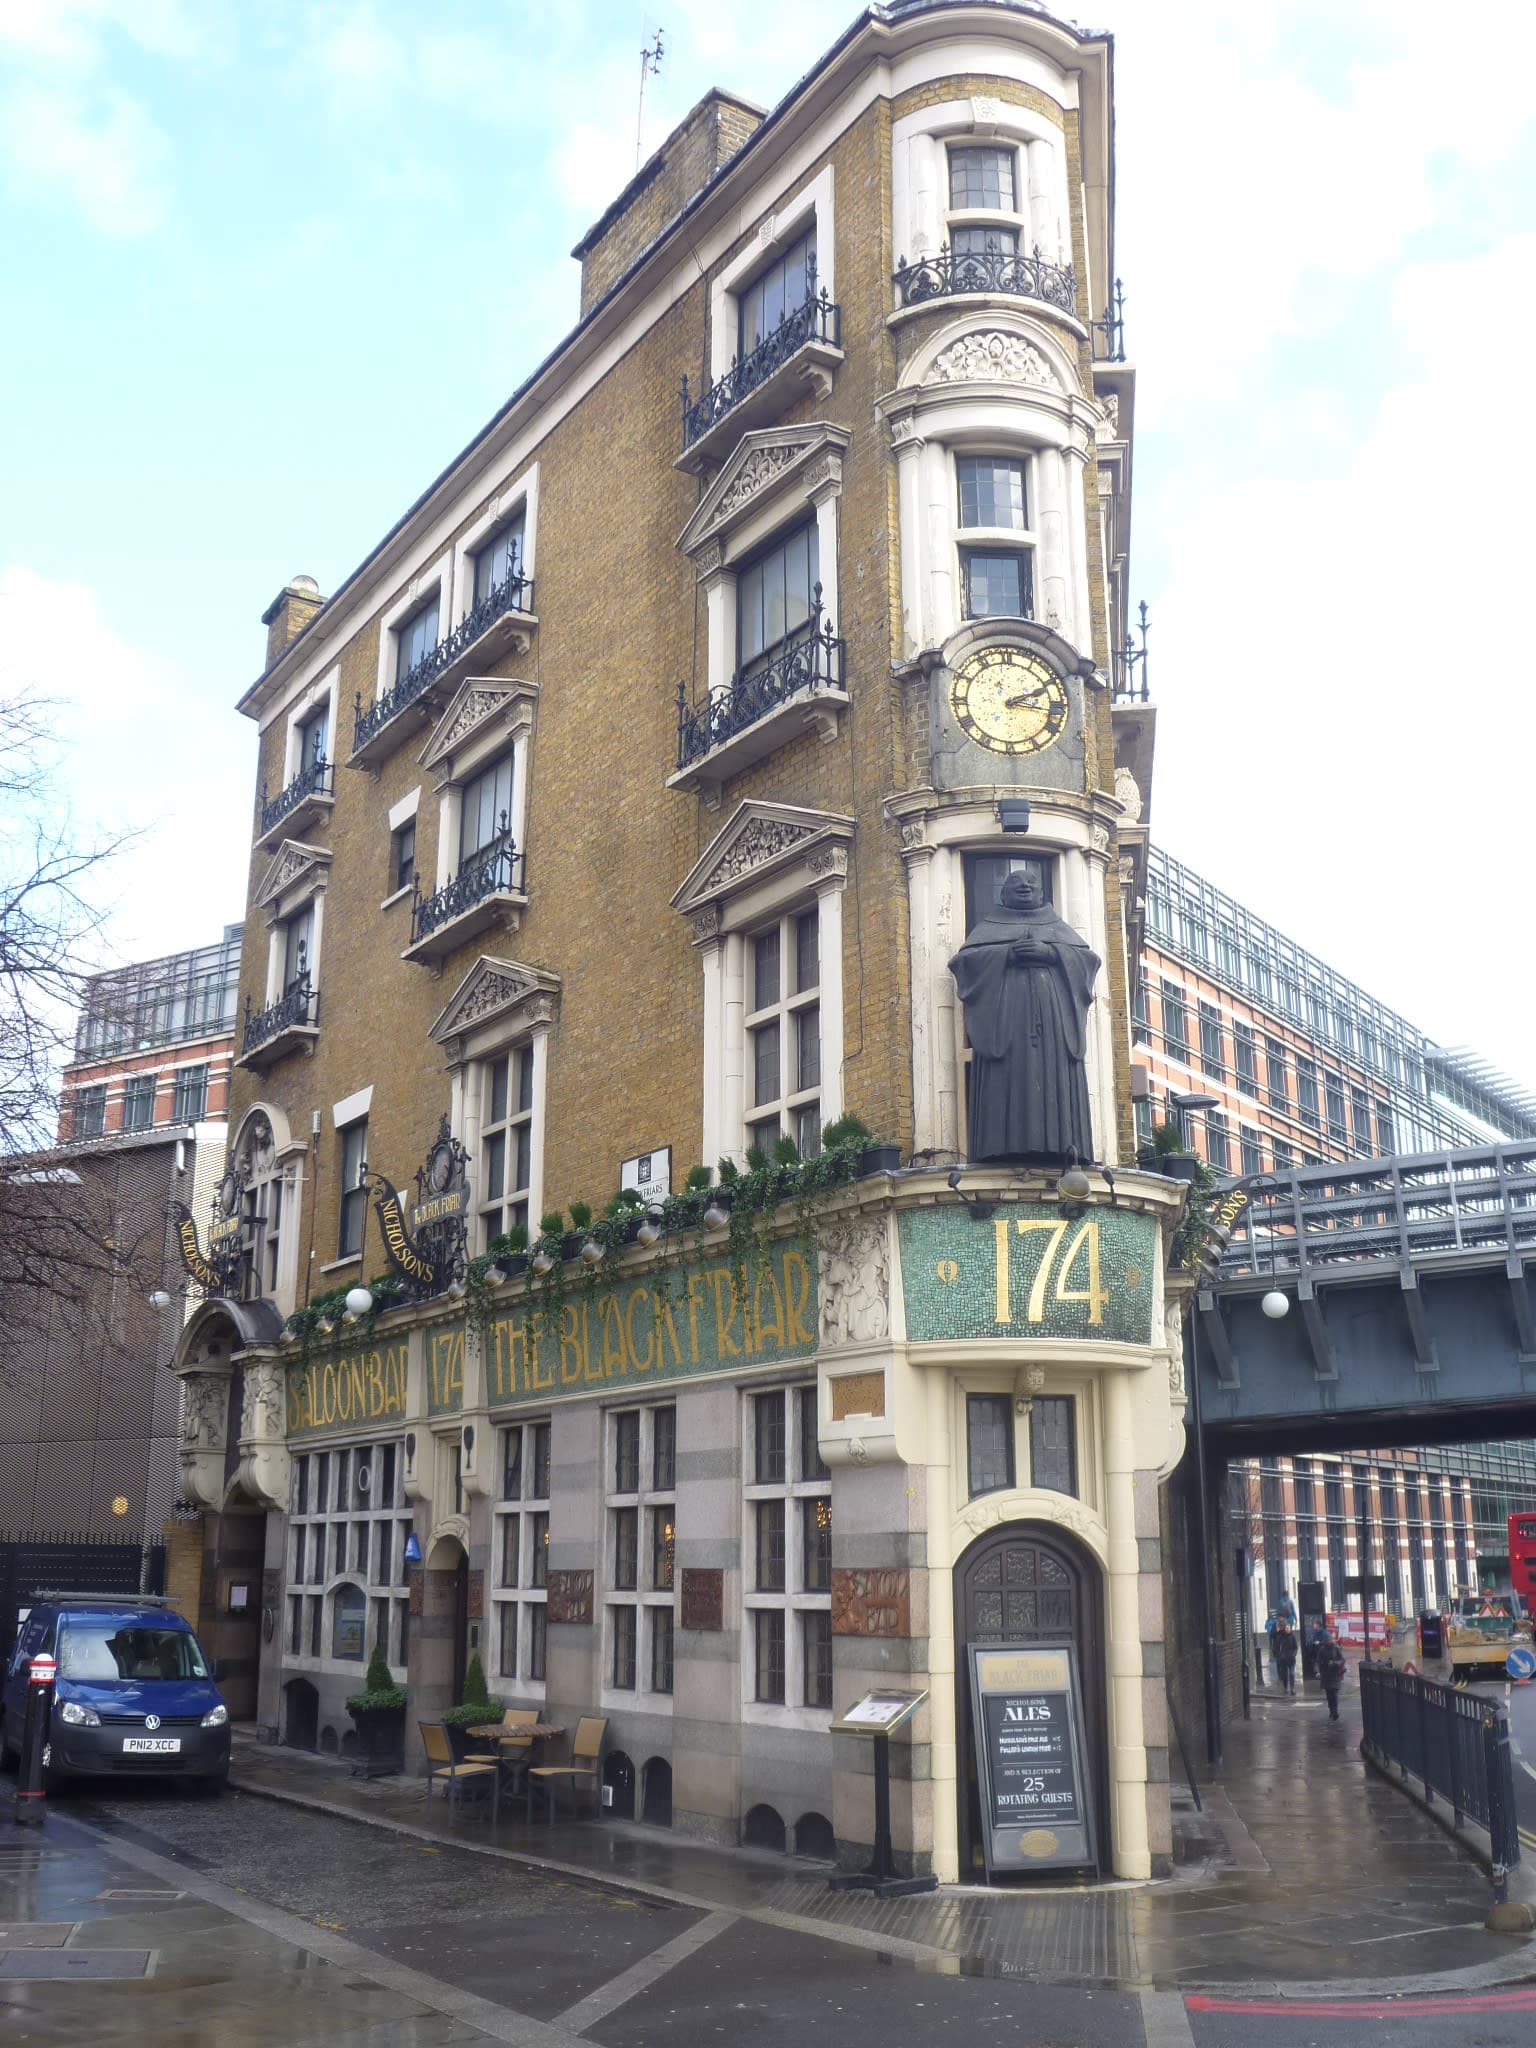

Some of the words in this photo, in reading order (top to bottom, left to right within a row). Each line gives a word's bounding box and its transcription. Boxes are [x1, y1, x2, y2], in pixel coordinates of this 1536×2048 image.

[641, 1184, 663, 1197] FRIARS
[994, 1219, 1110, 1324] 174
[489, 1311, 553, 1394] THE
[560, 1284, 683, 1384] BLACK
[688, 1252, 815, 1363] FRIAR
[1003, 1706, 1051, 1721] ALES
[130, 1740, 152, 1750] PN12
[155, 1740, 174, 1750] XCC
[1024, 1777, 1044, 1792] 25
[998, 1794, 1039, 1806] ROTATING
[1041, 1793, 1073, 1803] GUESTS
